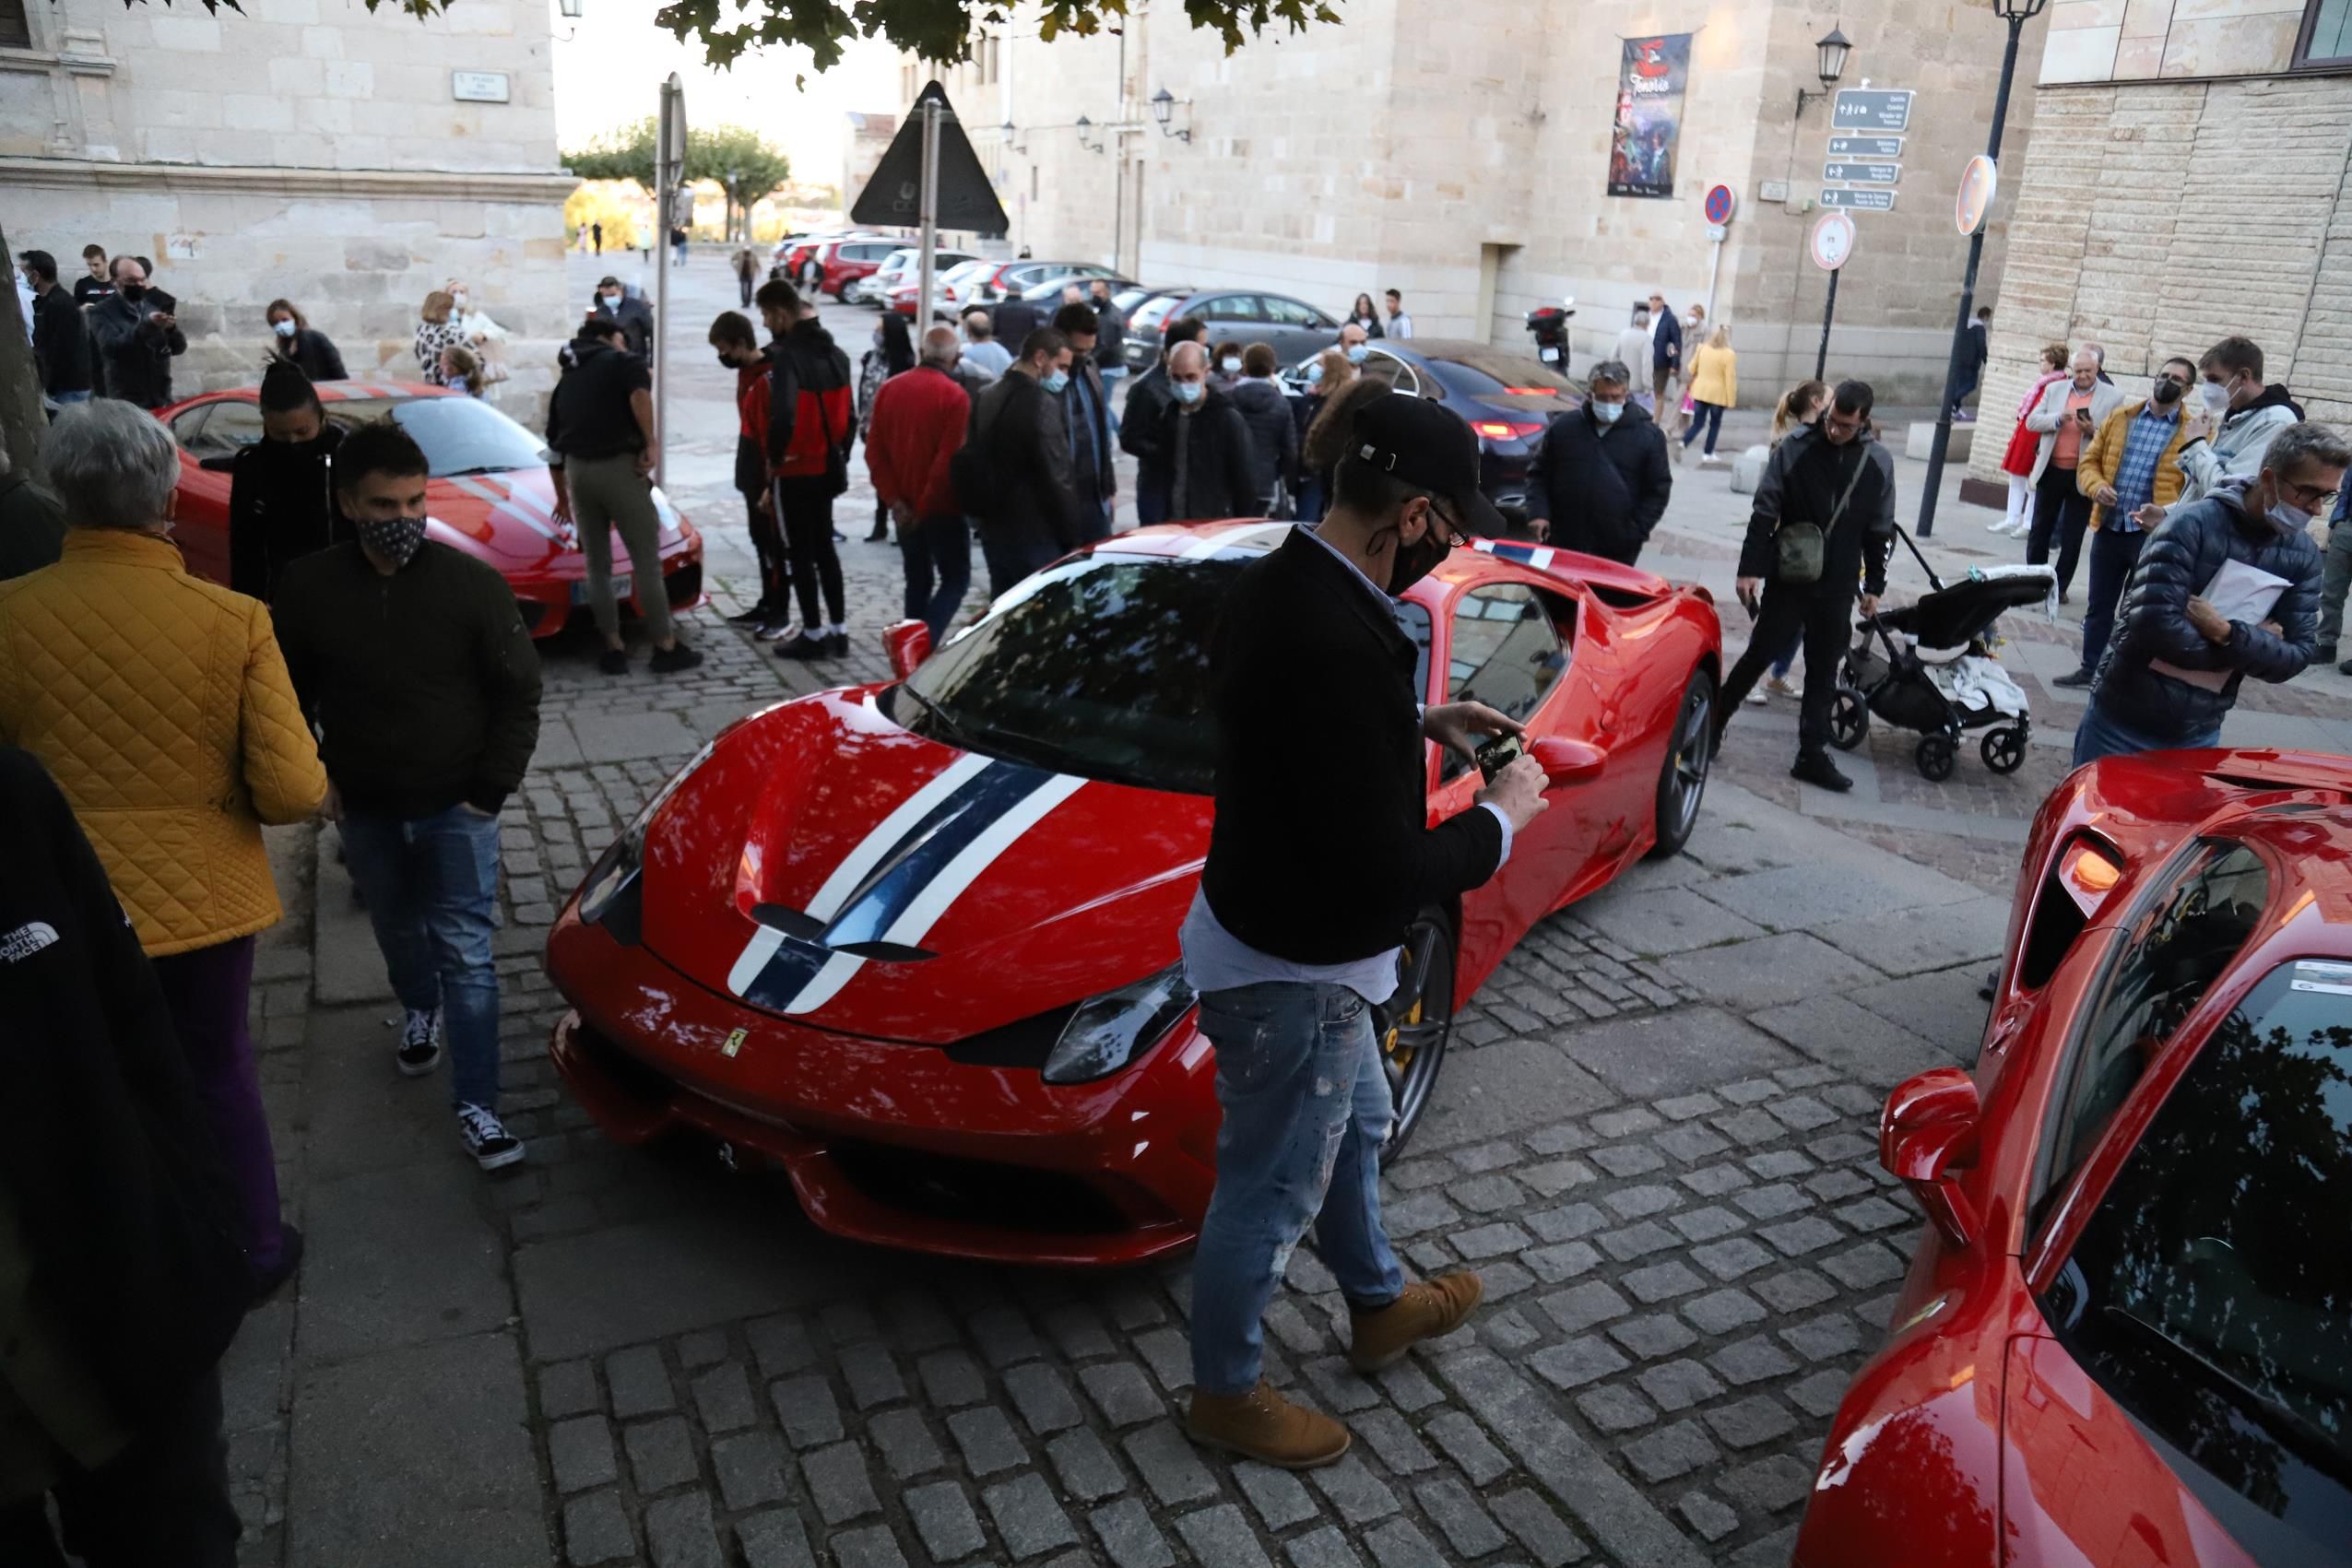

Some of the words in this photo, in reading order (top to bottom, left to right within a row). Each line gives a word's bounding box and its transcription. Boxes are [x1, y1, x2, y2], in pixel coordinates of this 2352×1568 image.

[3, 926, 30, 943] THE
[0, 934, 36, 959] ORTH
[8, 942, 41, 963] FACE
